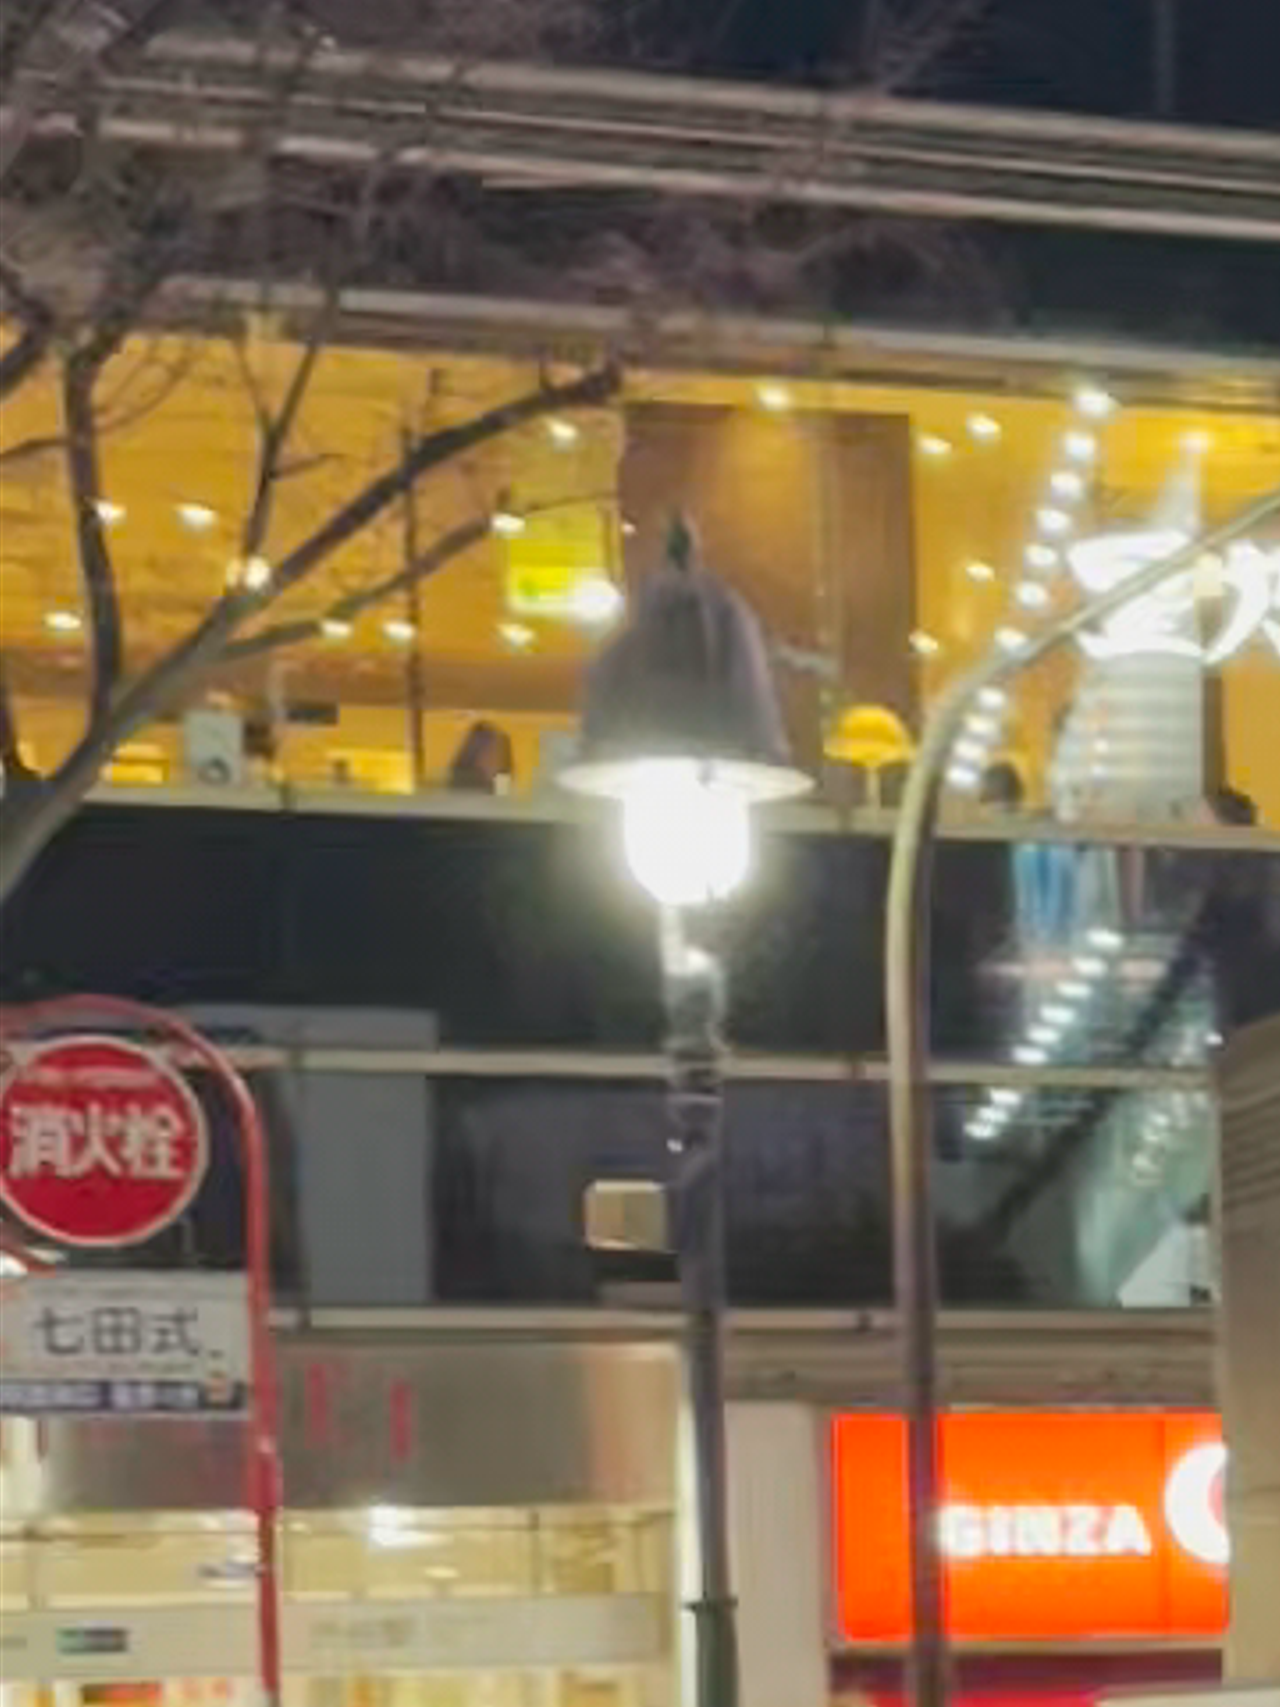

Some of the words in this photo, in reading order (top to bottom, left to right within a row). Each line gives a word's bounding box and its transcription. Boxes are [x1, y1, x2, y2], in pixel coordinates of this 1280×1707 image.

[8, 1102, 187, 1179] 消火栓
[31, 1306, 203, 1358] 七田式
[937, 1503, 1153, 1558] GINZA
